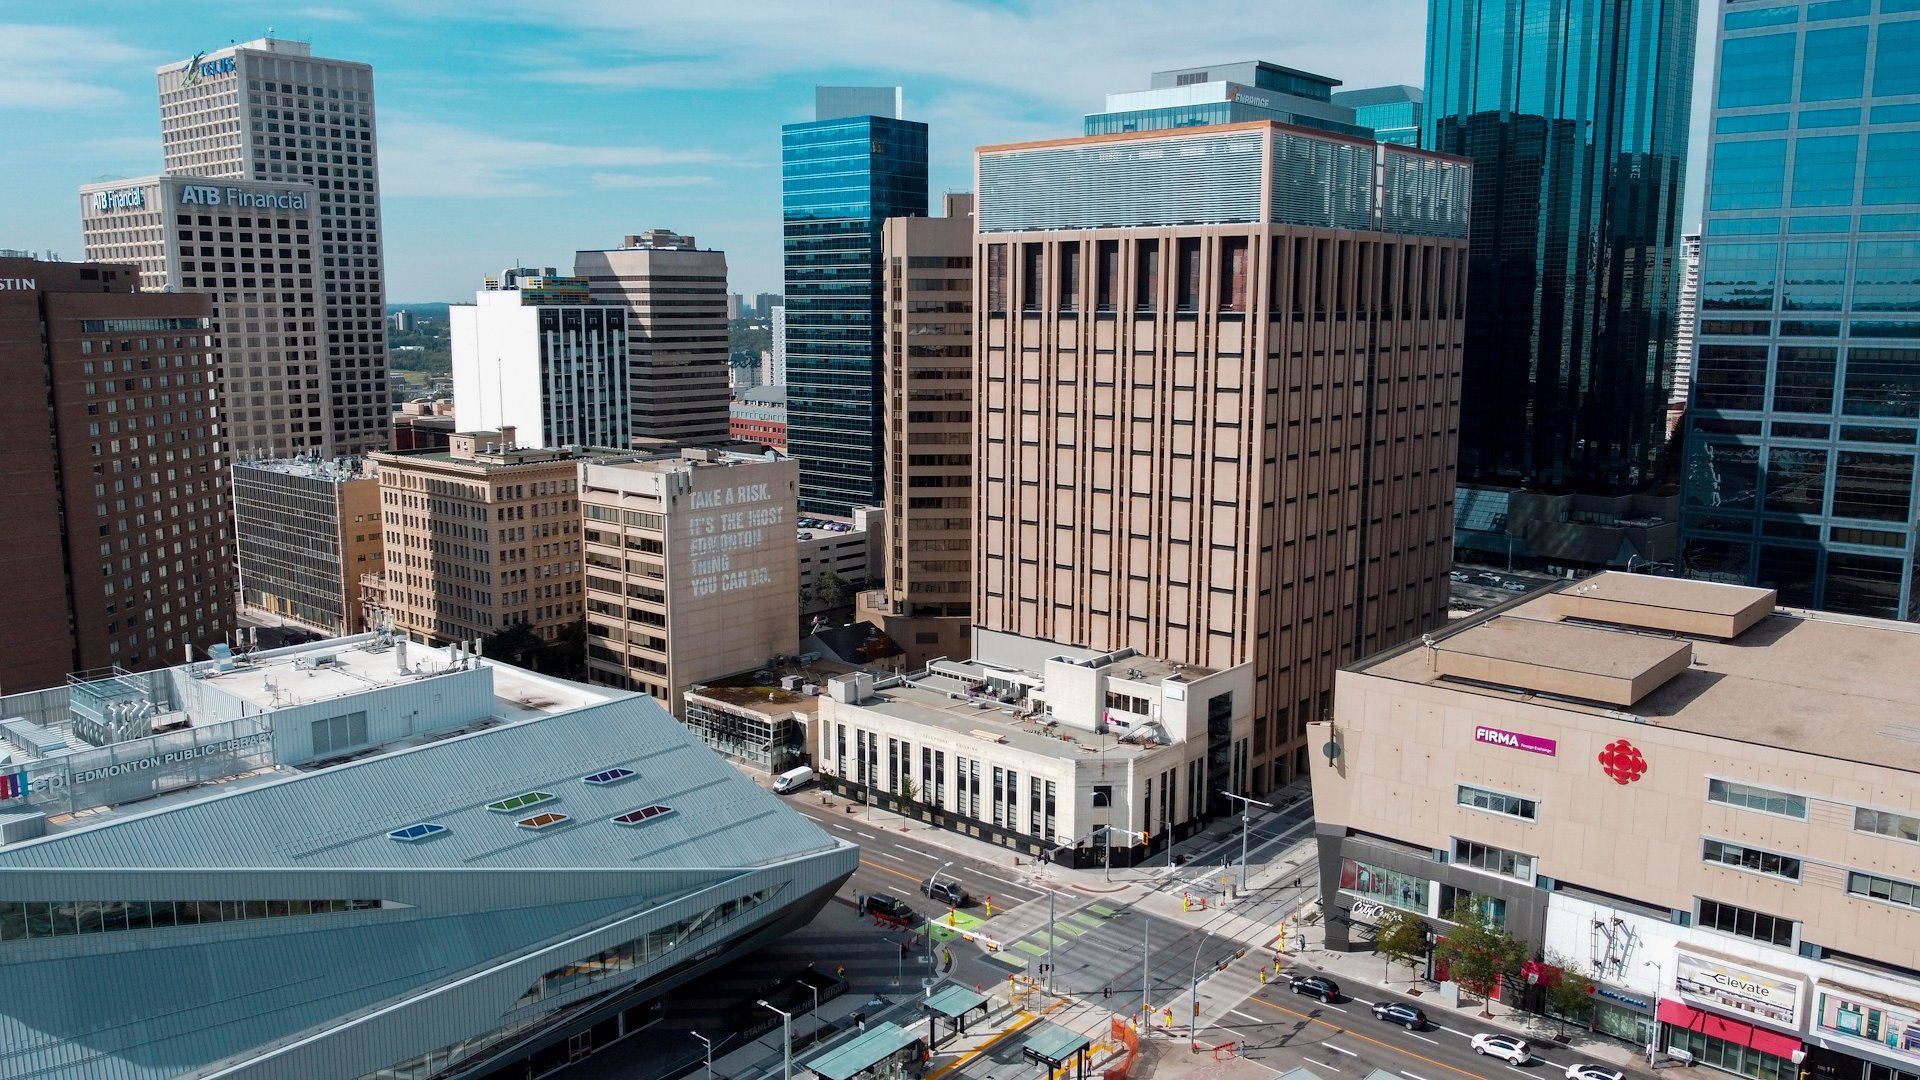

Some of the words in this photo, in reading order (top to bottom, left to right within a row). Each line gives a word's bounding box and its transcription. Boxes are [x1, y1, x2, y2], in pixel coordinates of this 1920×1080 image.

[200, 56, 236, 76] TELUS
[93, 191, 108, 210] ATB
[108, 187, 140, 208] Financial
[181, 185, 221, 205] ATB
[226, 187, 308, 209] Financial
[689, 488, 722, 510] TAKE
[725, 487, 735, 504] A
[738, 483, 771, 503] RISK.
[690, 516, 714, 536] IT'S
[721, 511, 744, 531] THE
[749, 506, 783, 527] MOST
[690, 529, 762, 557] EDMONTON
[691, 554, 730, 577] THING
[691, 575, 718, 597] YOU
[721, 570, 747, 592] CAN
[1476, 728, 1519, 747] FIRMA
[32, 769, 70, 795] epl
[75, 757, 161, 785] EDMONTON
[164, 743, 215, 765] PUBLIC
[218, 731, 274, 753] LIBRARY
[1713, 973, 1770, 997] Elevate
